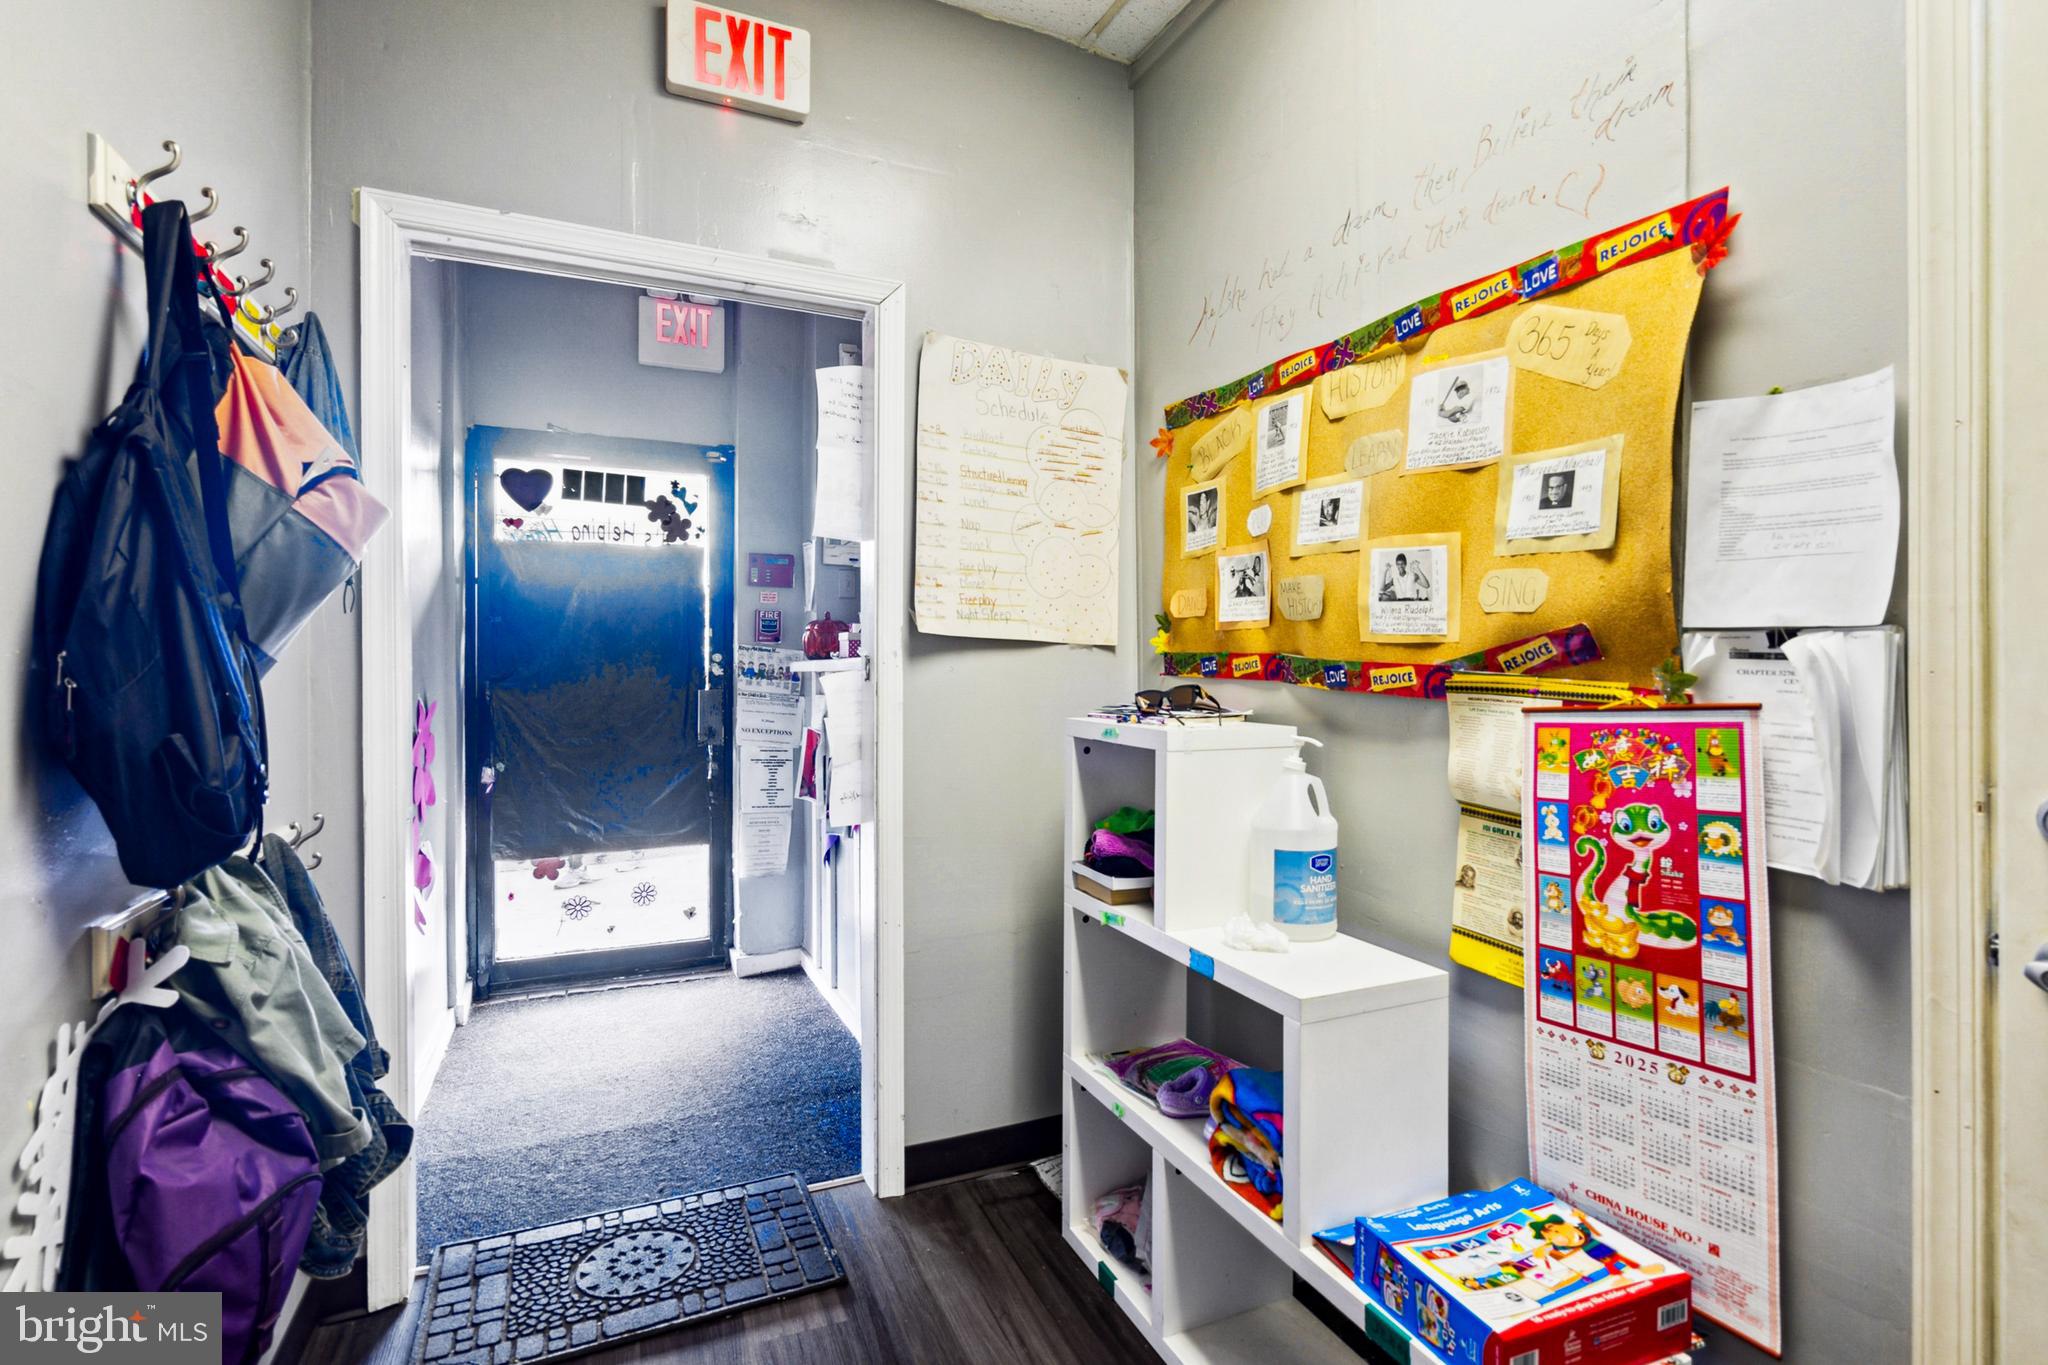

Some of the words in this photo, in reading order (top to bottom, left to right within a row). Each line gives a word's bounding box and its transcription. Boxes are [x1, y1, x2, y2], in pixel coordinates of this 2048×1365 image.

[694, 6, 792, 101] EXIT
[1249, 376, 1265, 396] LOVE
[1281, 355, 1314, 380] REJOICE
[1353, 317, 1390, 352] PEACE
[1395, 311, 1422, 338] LOVE
[1455, 278, 1510, 313] REJOICE
[1524, 263, 1557, 293] LOVE
[1600, 220, 1667, 262] REJOICE
[656, 302, 712, 349] EXIT
[1518, 316, 1575, 361] 365
[976, 388, 1049, 422] Schedule
[1199, 422, 1242, 473] BLACK
[961, 518, 981, 531] Nap
[1484, 576, 1537, 607] SING
[760, 611, 779, 619] FIRE
[1201, 660, 1218, 672] LOVE
[1234, 659, 1260, 673] REJOICE
[1324, 669, 1347, 684] LOVE
[1372, 671, 1414, 686] REJOICE
[1503, 641, 1553, 672] REJOICE
[752, 728, 793, 736] EXCEPTIONS
[1492, 826, 1514, 837] GREAT
[1310, 874, 1333, 884] HAND
[1615, 1051, 1659, 1074] 2025
[1407, 1213, 1474, 1232] Language
[1473, 1201, 1502, 1218] Arts
[1585, 1188, 1621, 1211] CHINA
[1625, 1206, 1669, 1232] HOUSE
